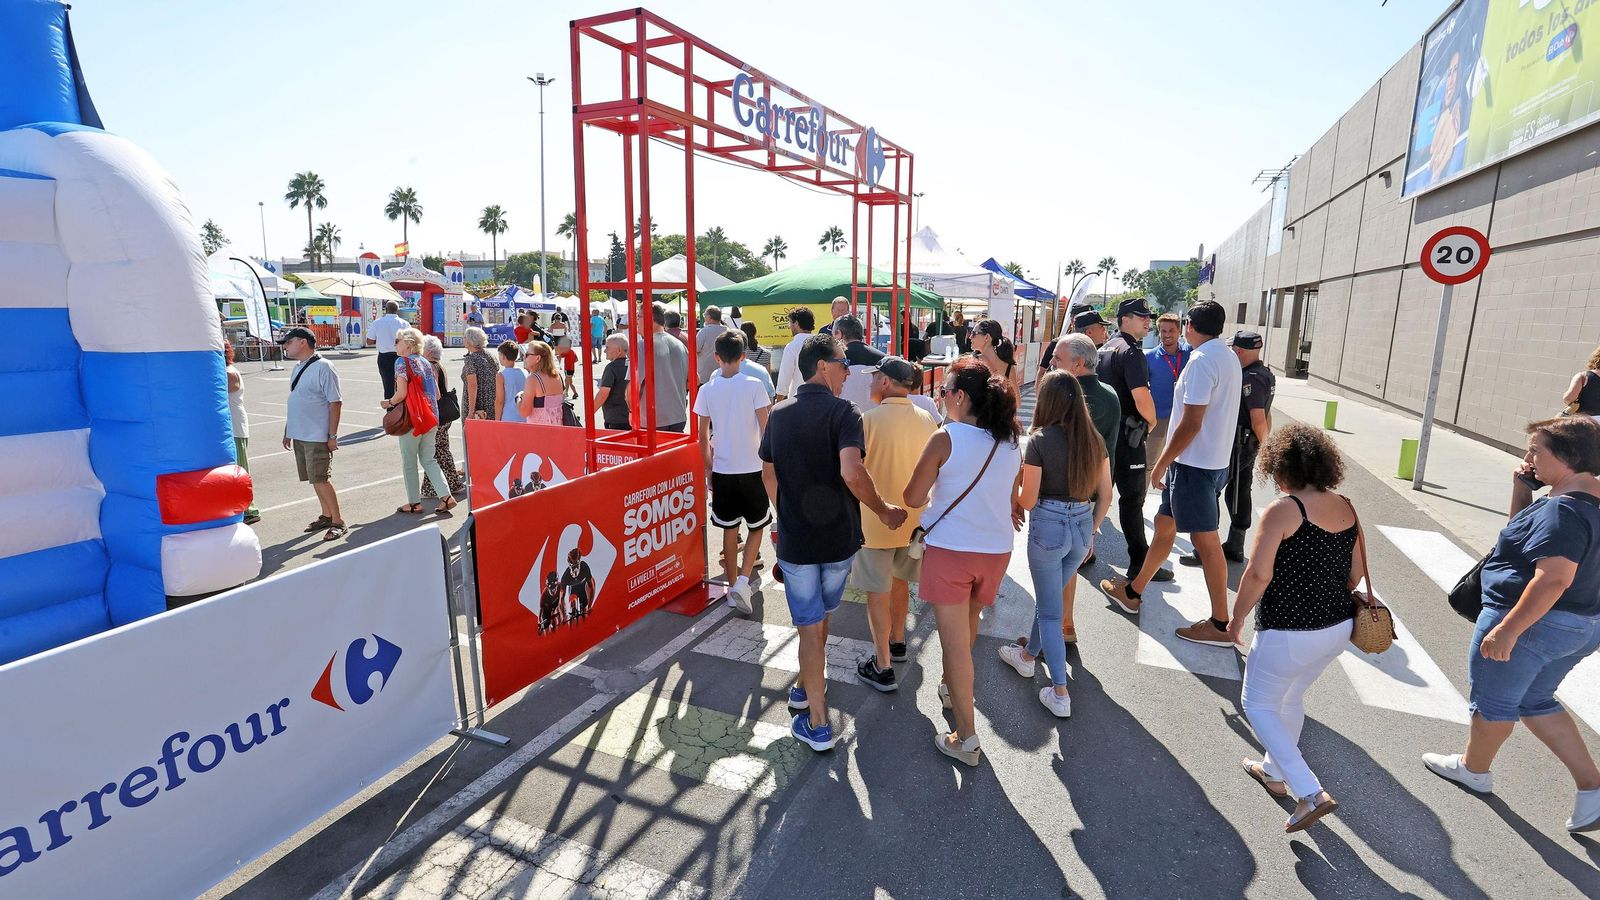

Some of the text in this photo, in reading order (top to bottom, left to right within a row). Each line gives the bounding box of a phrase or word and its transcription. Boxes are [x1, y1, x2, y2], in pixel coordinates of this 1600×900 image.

[1505, 25, 1543, 63] todos
[732, 72, 850, 166] Carrefour
[1436, 246, 1474, 265] 20
[488, 333, 508, 341] ELENO
[774, 315, 790, 323] CAS
[624, 471, 694, 508] CARREFOUR CON LA VUELTA
[623, 485, 695, 536] SOMOS
[623, 511, 697, 567] EQUIPO
[0, 697, 291, 877] arrefour
